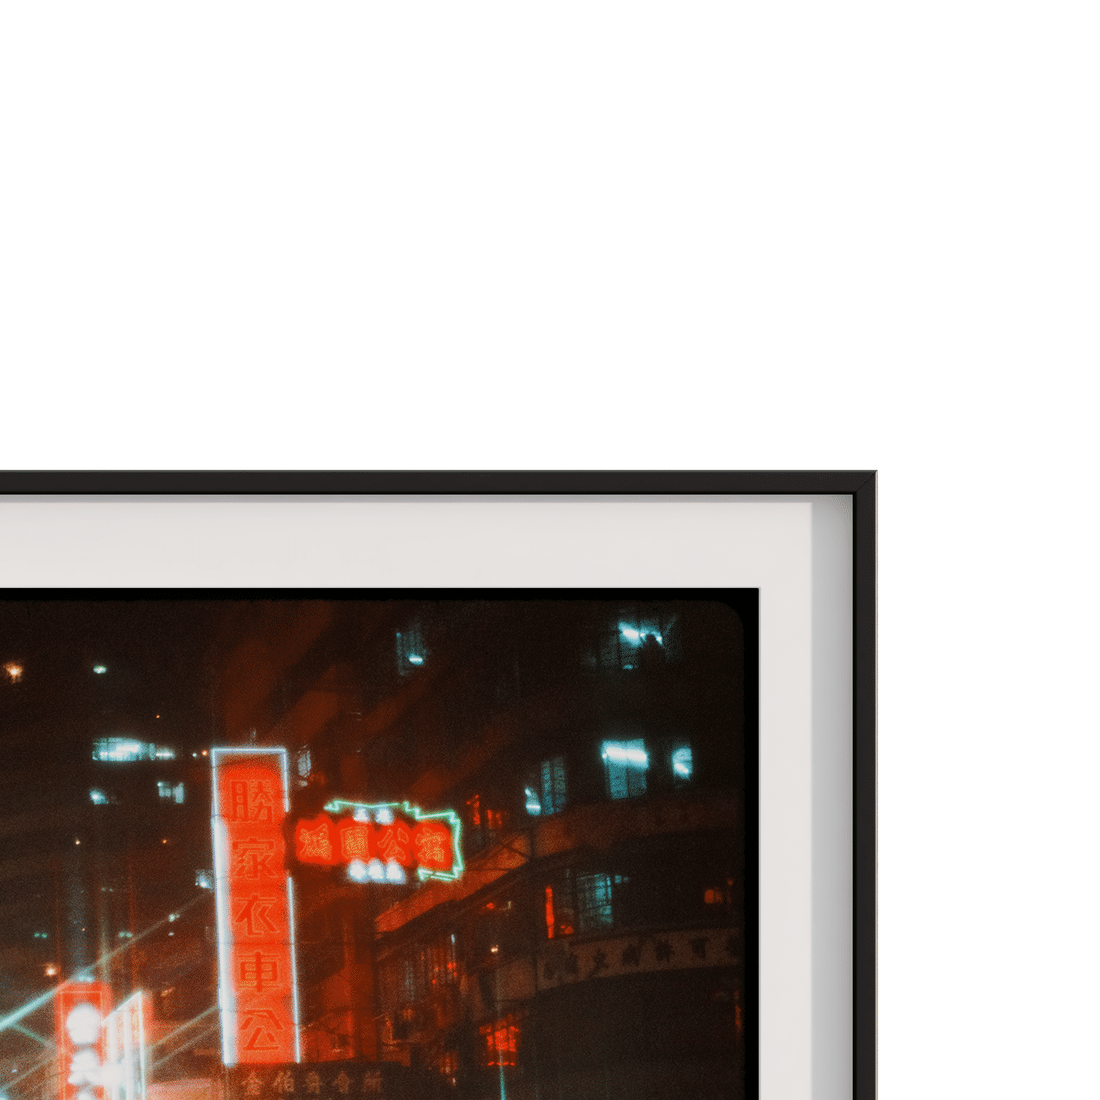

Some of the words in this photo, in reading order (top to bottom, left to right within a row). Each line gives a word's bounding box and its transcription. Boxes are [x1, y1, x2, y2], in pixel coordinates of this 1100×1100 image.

[229, 778, 284, 1053] 勝家衣車公
